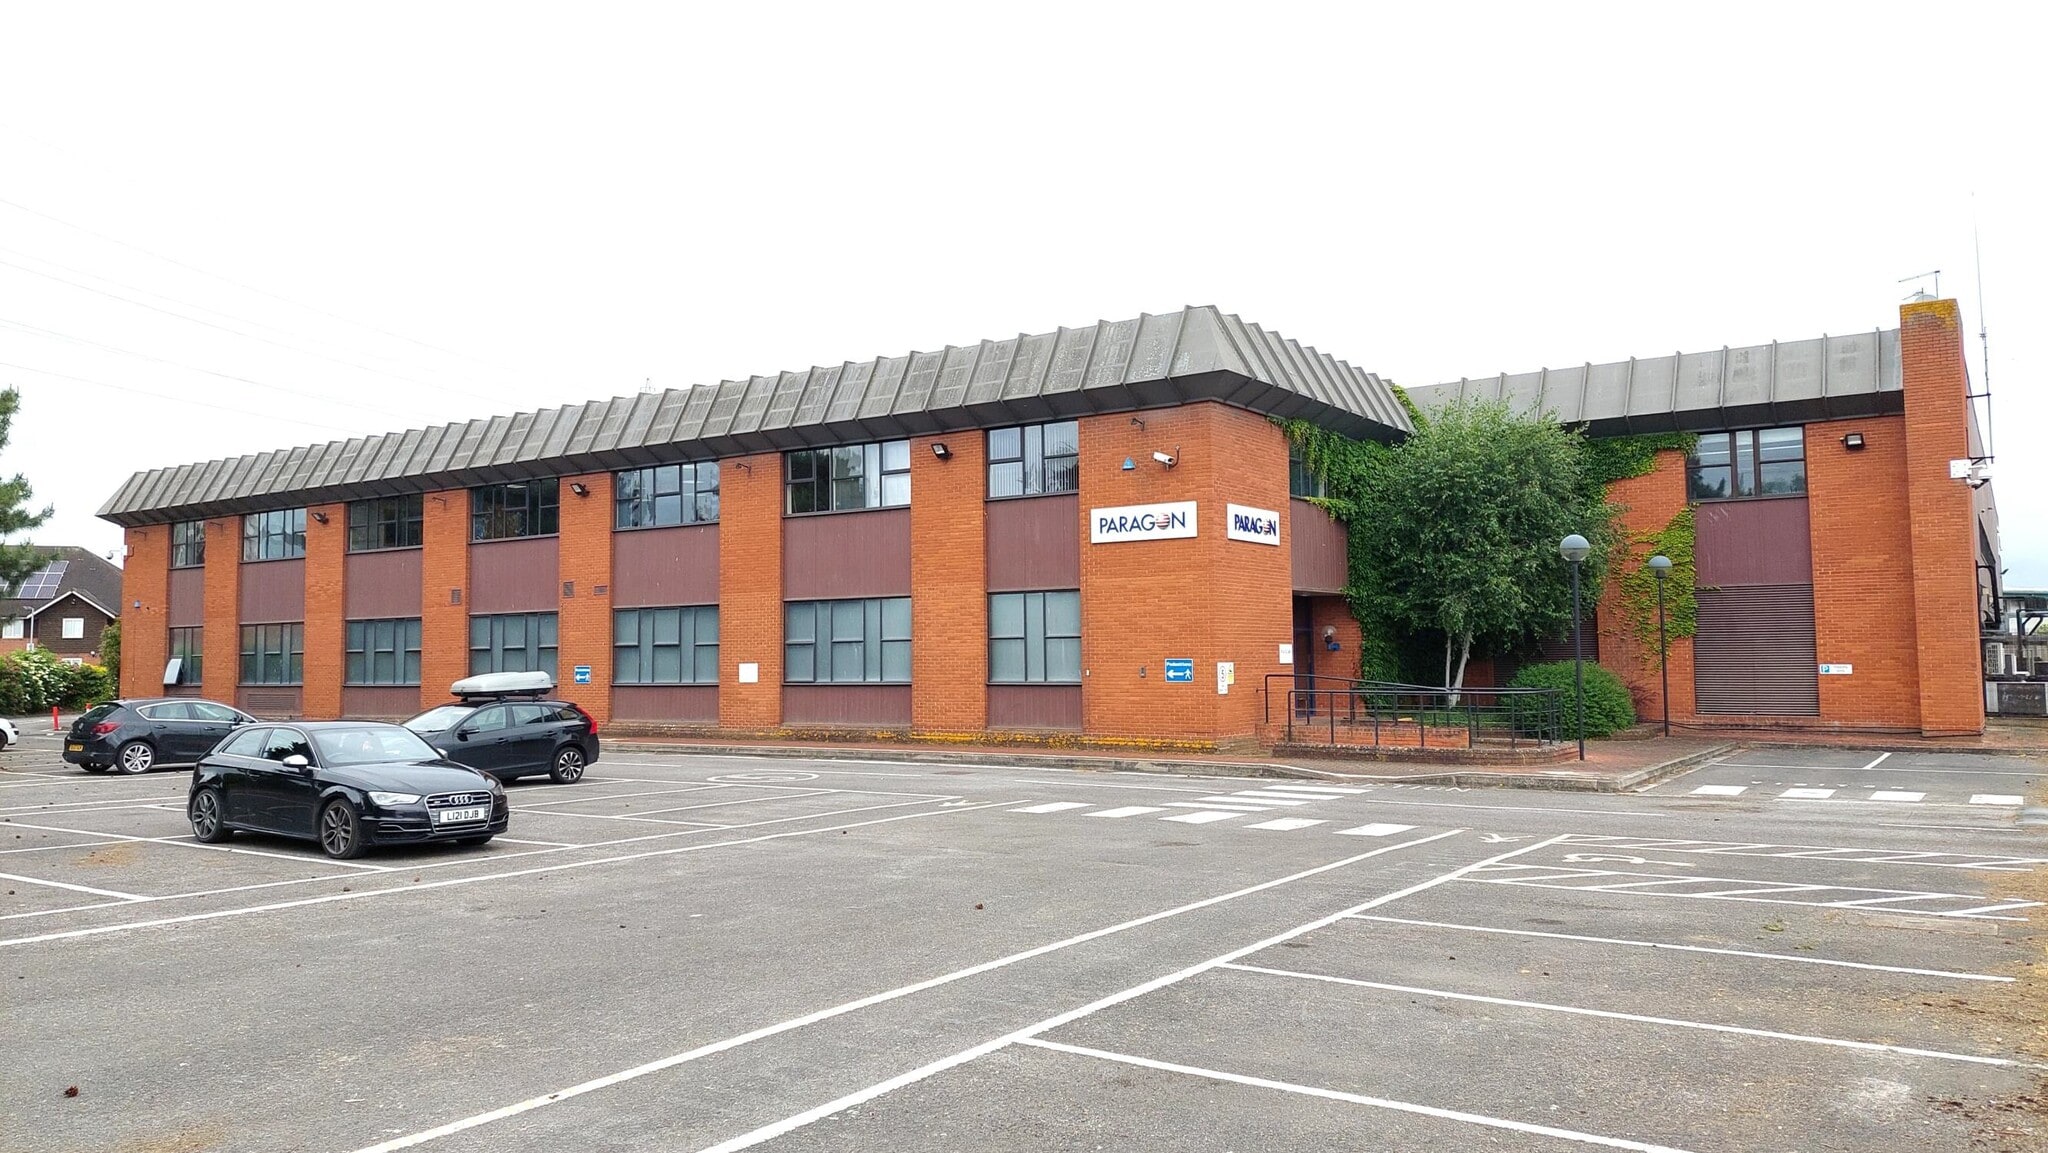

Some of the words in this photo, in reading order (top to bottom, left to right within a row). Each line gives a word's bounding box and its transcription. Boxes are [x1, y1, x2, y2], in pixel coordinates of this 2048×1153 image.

[1100, 511, 1186, 534] PARAGON
[1234, 513, 1277, 537] PARAGON
[464, 809, 479, 819] DJB
